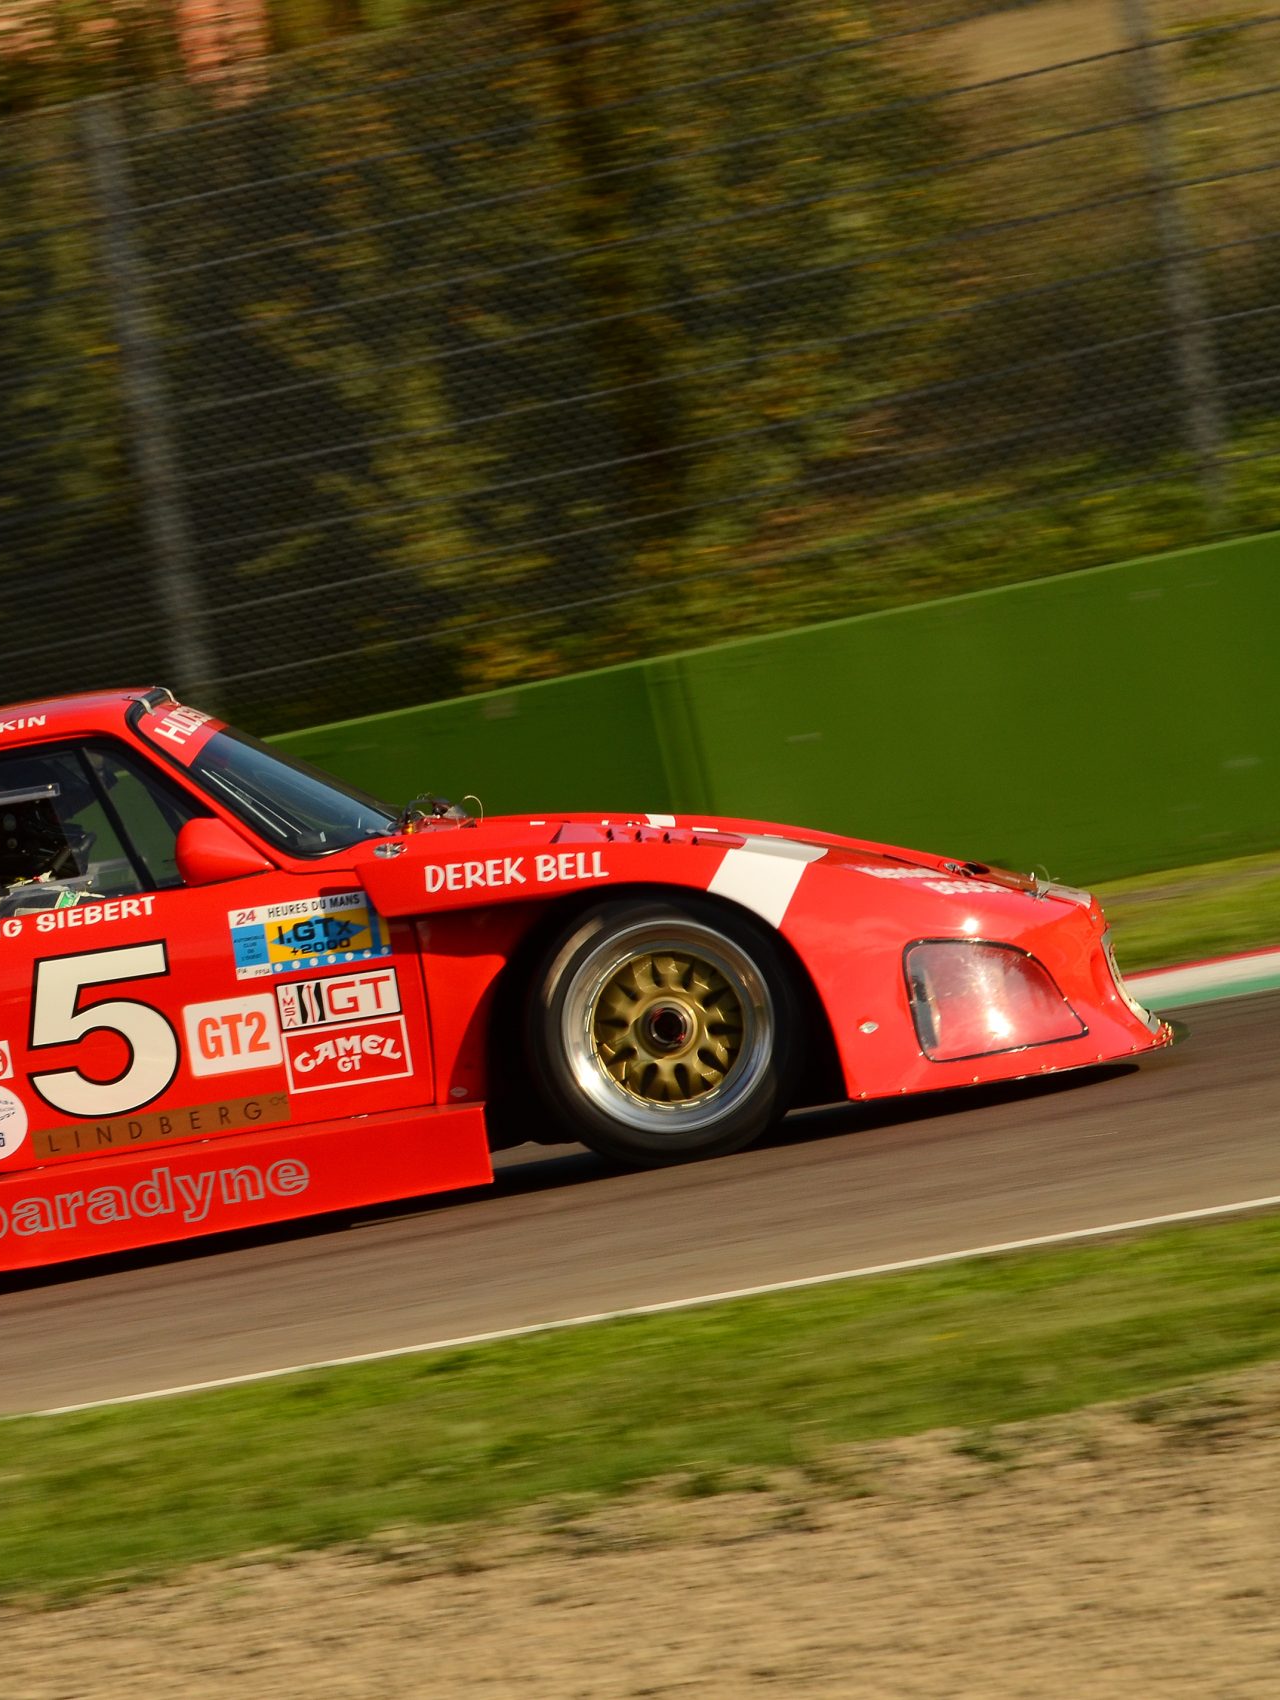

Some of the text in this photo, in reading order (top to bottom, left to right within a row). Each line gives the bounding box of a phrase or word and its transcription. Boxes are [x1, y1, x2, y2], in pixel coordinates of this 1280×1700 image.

[424, 851, 609, 893] DEREK BELL
[36, 896, 155, 933] SIEBERT
[236, 893, 361, 926] 24 HEURES DU MANS
[282, 986, 298, 1027] IMSA
[327, 975, 391, 1015] GT
[28, 938, 181, 1119] 5
[197, 1012, 271, 1060] GT2
[293, 1034, 402, 1073] CAMEL
[337, 1053, 362, 1073] GT
[47, 1101, 262, 1153] LINDBERG
